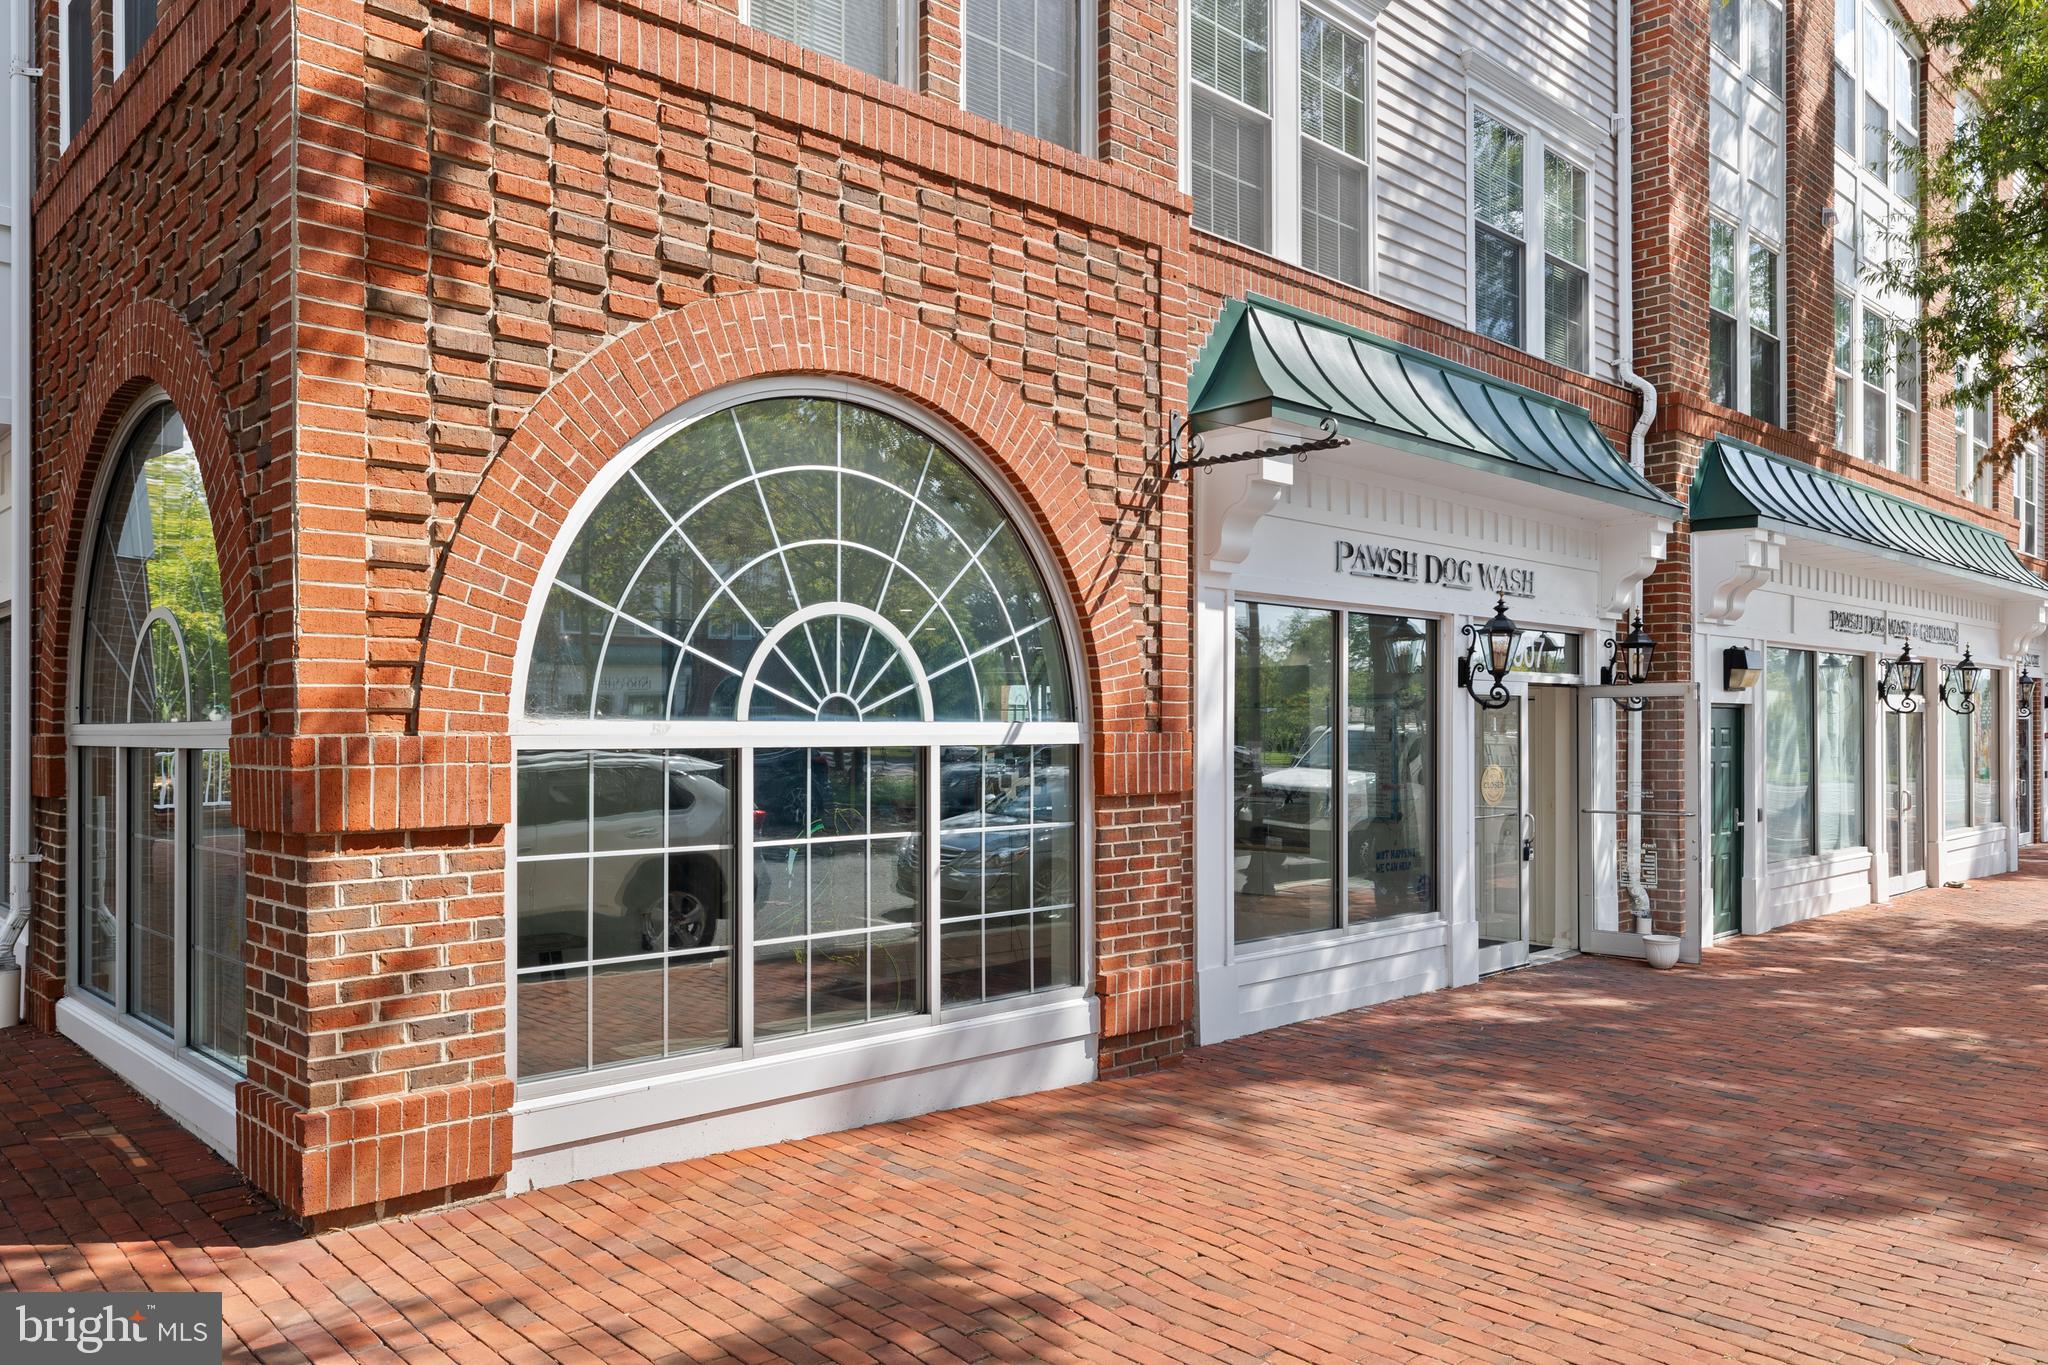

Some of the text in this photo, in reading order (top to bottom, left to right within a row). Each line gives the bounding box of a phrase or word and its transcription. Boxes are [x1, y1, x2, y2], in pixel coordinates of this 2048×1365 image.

[1335, 540, 1536, 594] PAWSH DOG WASH
[1483, 781, 1504, 789] CLOSED
